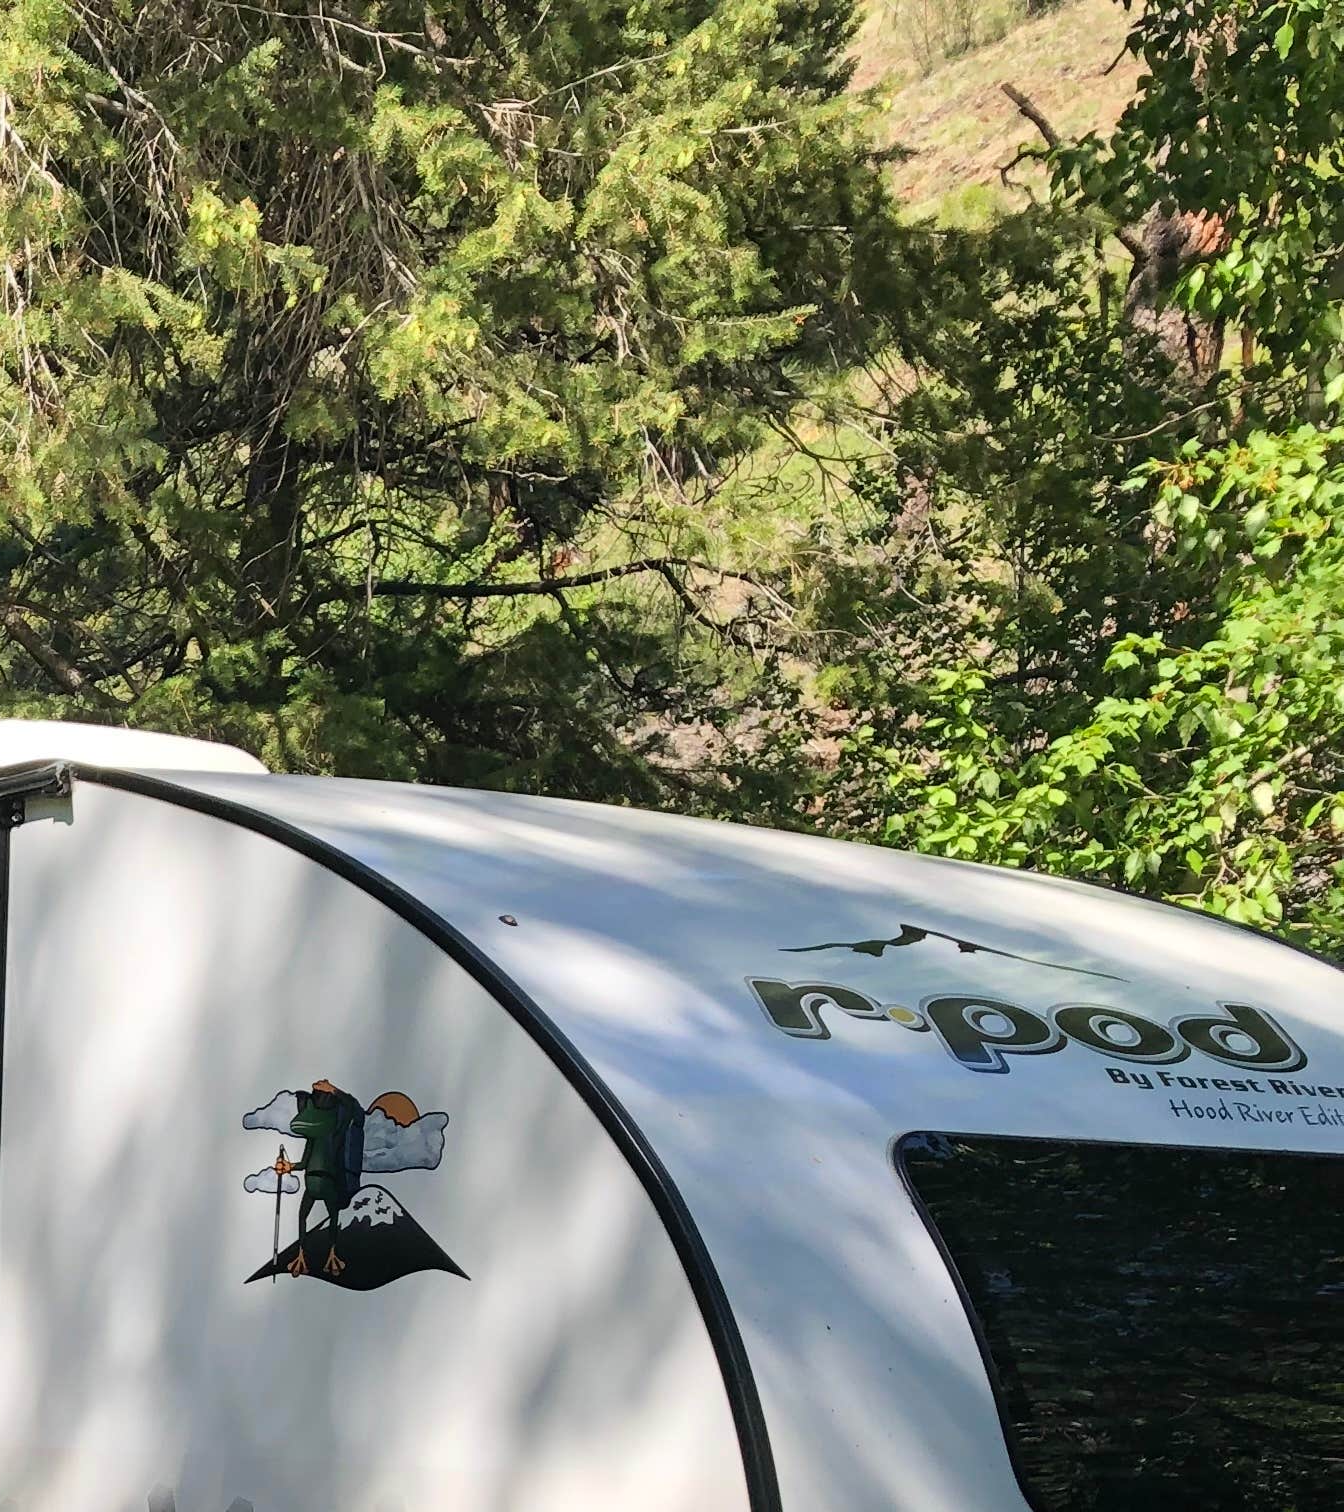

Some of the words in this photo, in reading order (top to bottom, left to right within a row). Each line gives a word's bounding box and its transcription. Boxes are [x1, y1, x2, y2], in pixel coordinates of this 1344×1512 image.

[1105, 1068, 1154, 1090] By
[1157, 1071, 1265, 1093] Forest
[1169, 1098, 1233, 1121] Hood
[1233, 1102, 1293, 1123] River
[1297, 1105, 1344, 1127] Edit
